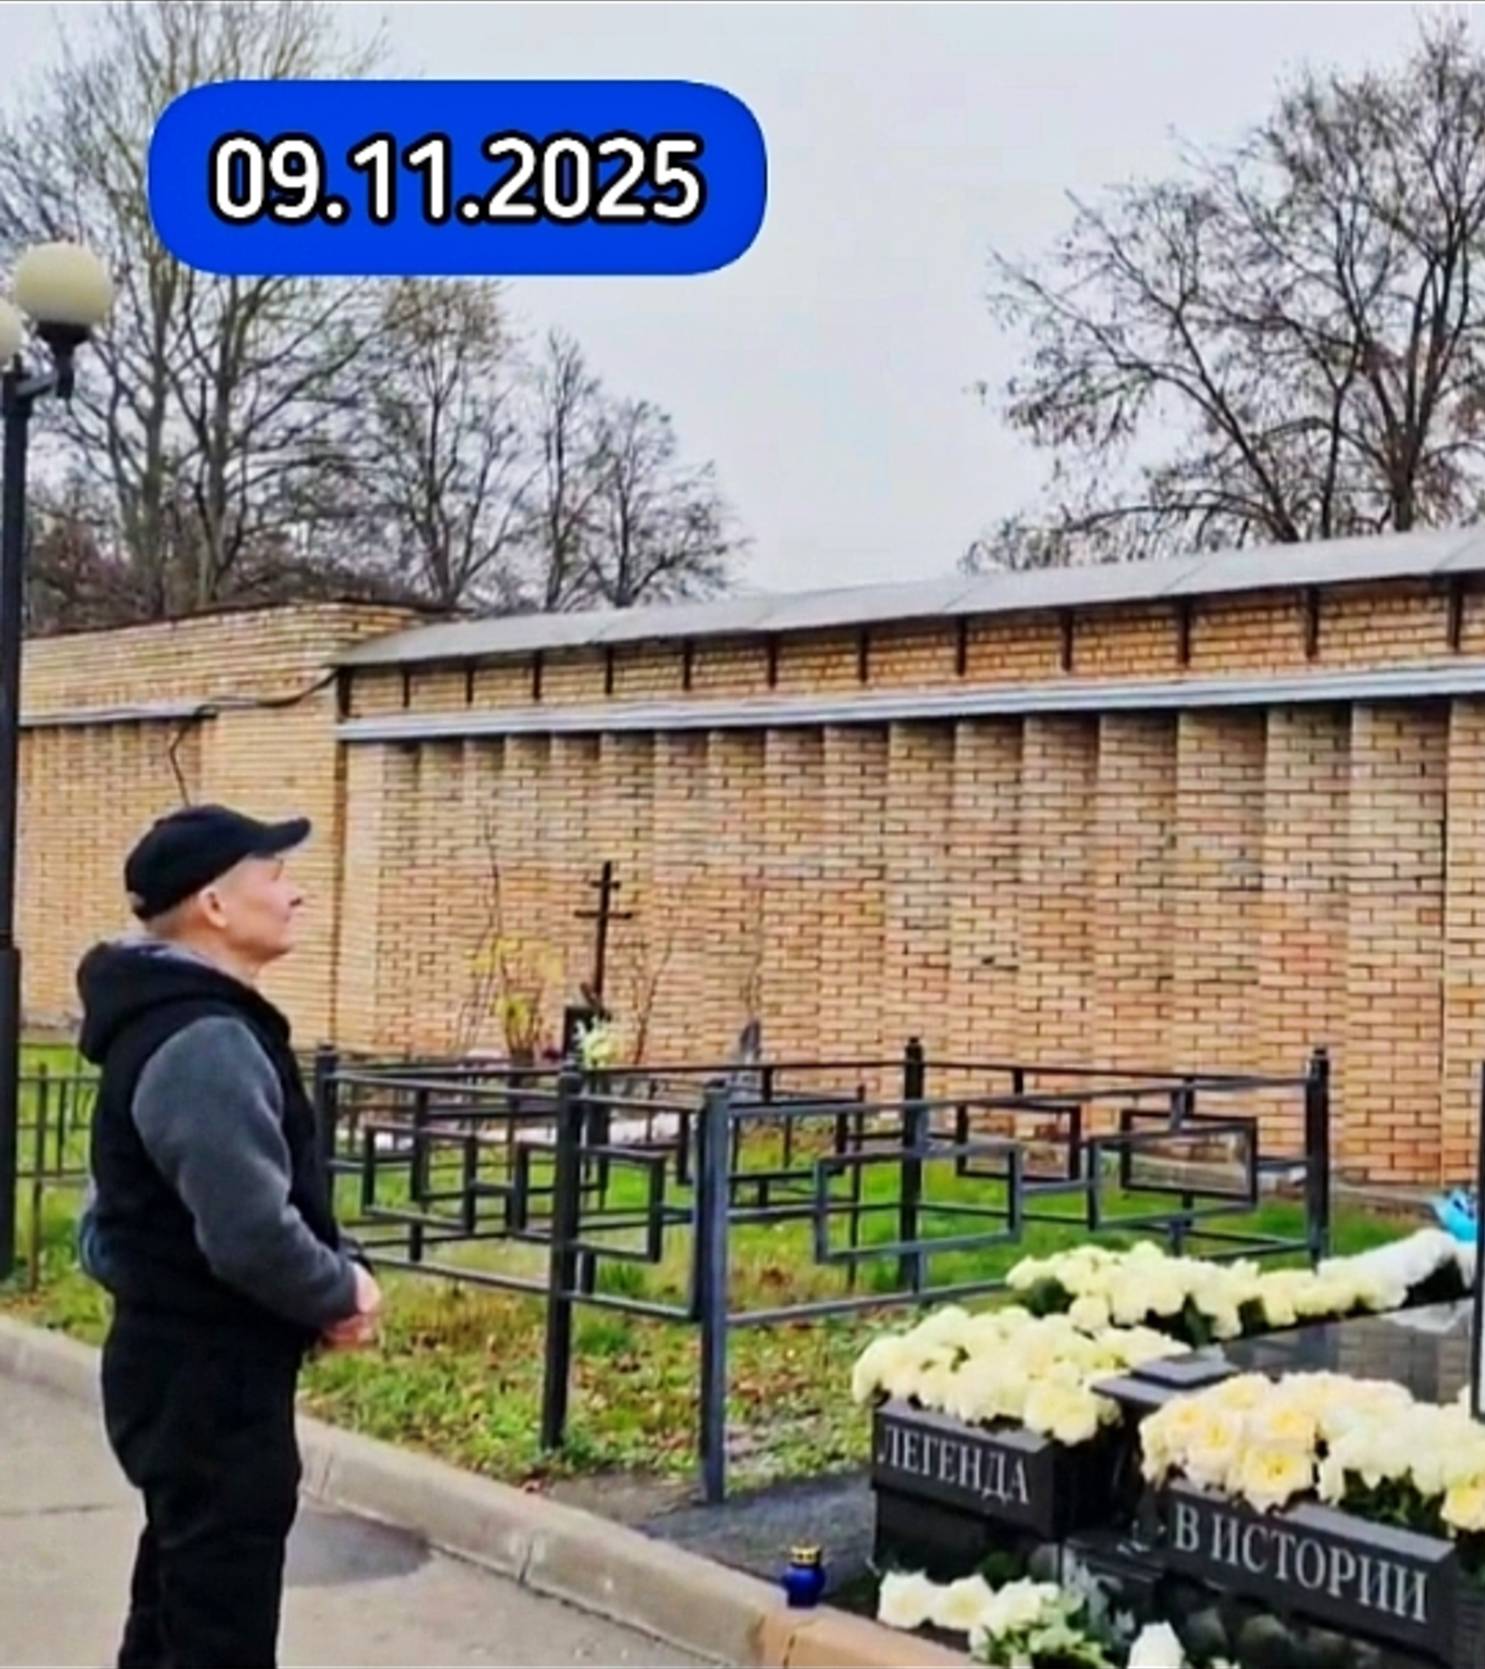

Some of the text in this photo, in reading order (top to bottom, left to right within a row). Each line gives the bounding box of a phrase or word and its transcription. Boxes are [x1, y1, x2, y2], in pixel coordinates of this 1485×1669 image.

[876, 1423, 1030, 1507] ЛЕГЕНДА
[1173, 1501, 1200, 1553] В
[1211, 1511, 1428, 1624] ИСТОРИИ
